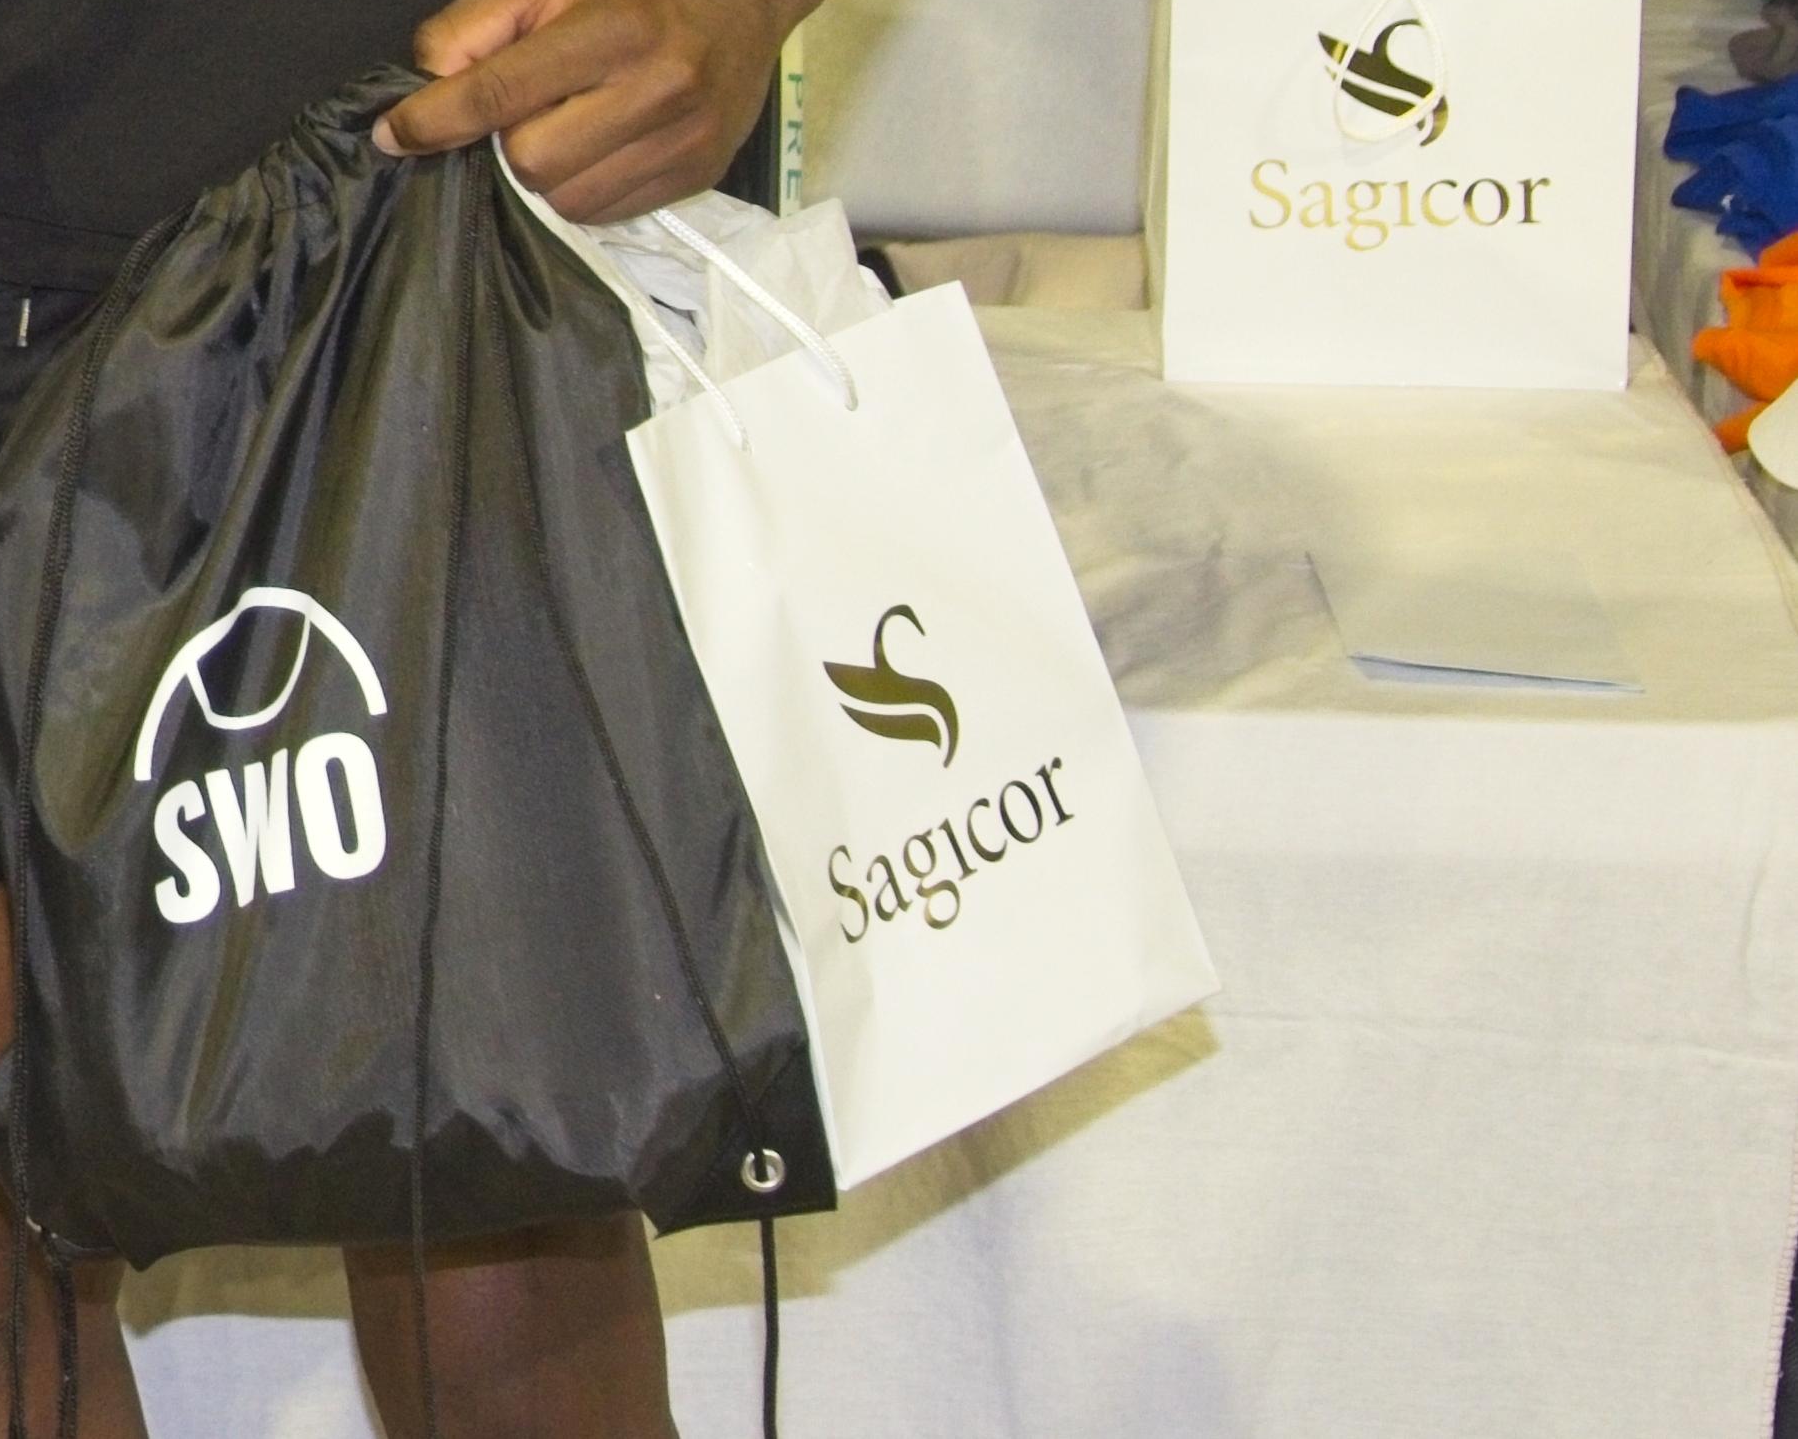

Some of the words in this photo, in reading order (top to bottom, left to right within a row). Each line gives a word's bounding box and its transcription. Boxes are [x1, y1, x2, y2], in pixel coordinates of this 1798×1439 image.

[1249, 158, 1552, 252] Sagicor
[153, 731, 387, 924] SWO
[827, 756, 1075, 944] Sagicor
